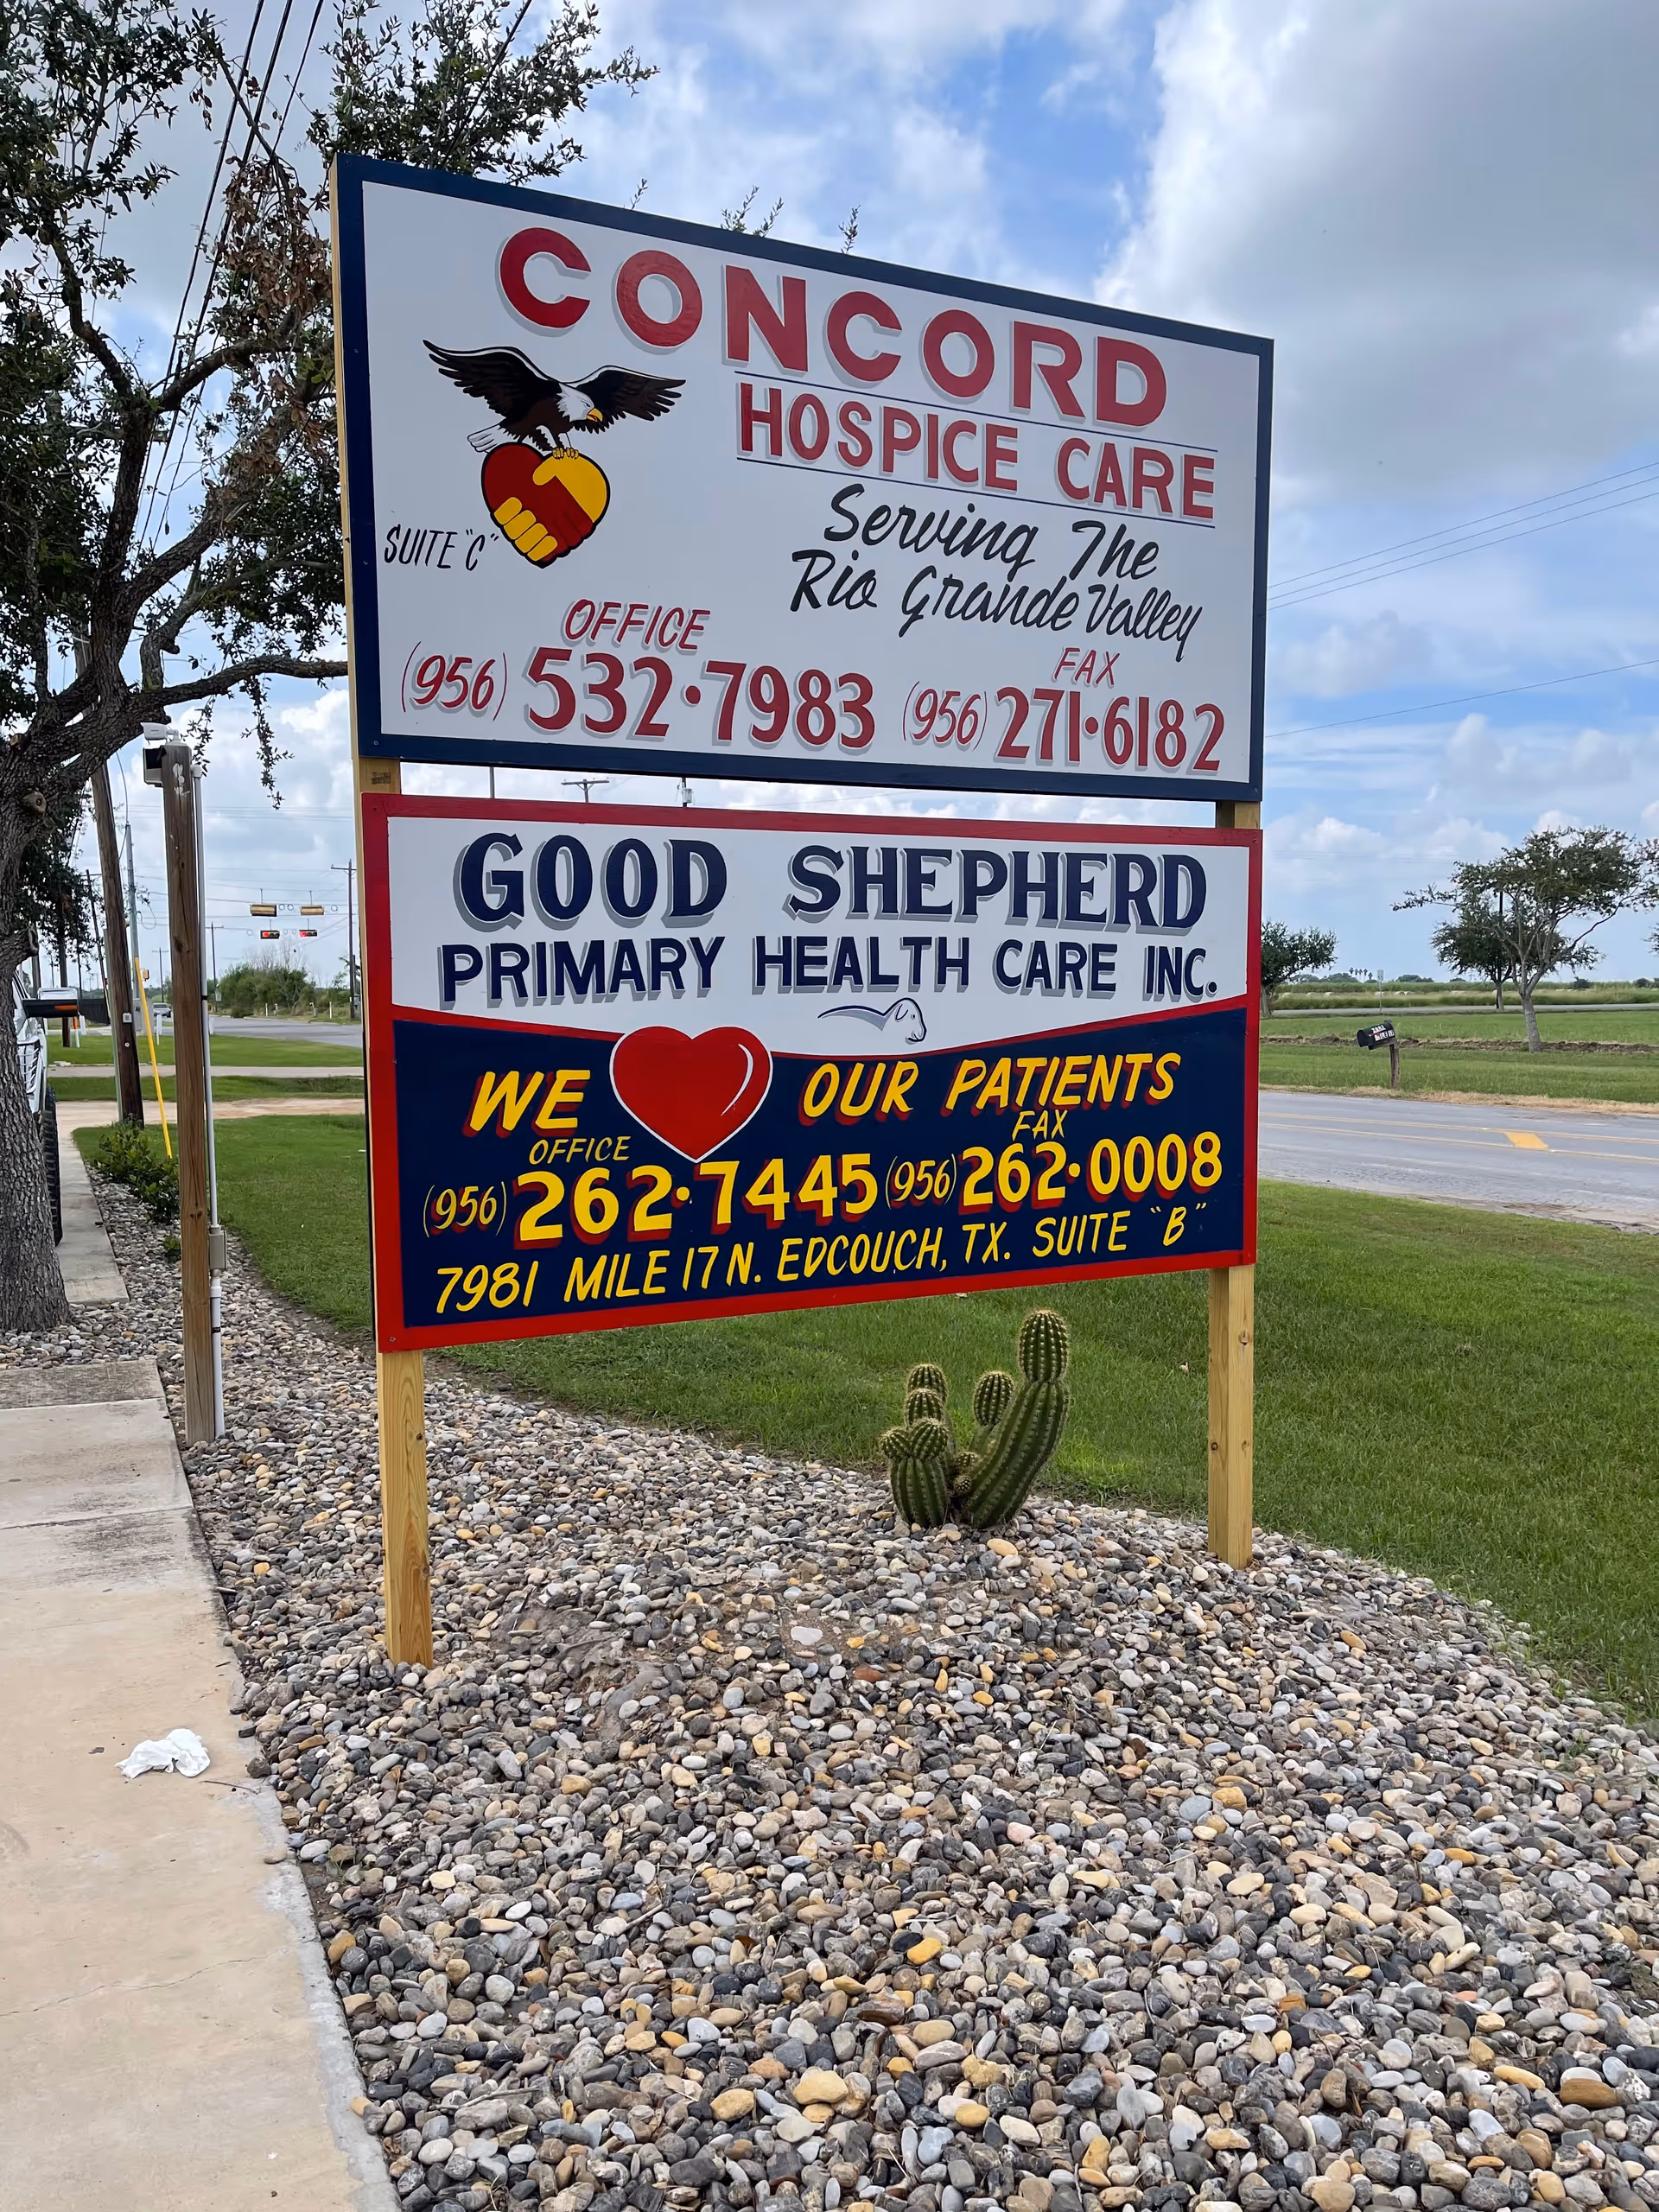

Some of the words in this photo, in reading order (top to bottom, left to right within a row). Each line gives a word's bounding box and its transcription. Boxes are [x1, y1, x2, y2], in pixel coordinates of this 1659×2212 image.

[497, 226, 1167, 428] CONCORD
[738, 382, 1019, 493] HOSPICE
[1056, 437, 1215, 519] CARE
[384, 524, 458, 569] SUITE
[823, 483, 1039, 581] Serving
[1069, 520, 1160, 581] The
[563, 598, 711, 652] OFFICE
[790, 549, 878, 613] Rio
[899, 565, 1081, 638] Grande
[1085, 584, 1204, 663] Valley
[400, 640, 508, 722] (956)
[1052, 646, 1121, 687] FAX
[902, 681, 989, 751] (956)
[457, 832, 728, 925] GOOD
[785, 844, 1207, 932] SHEPHERD
[440, 935, 726, 1005] PRIMARY
[753, 935, 970, 990] HEALTH
[995, 938, 1118, 995] CARE
[1144, 944, 1218, 998] INC.
[467, 1069, 591, 1134] WE
[801, 1060, 919, 1121] OUR
[944, 1052, 1181, 1112] PATIENTS
[1011, 1109, 1069, 1141] FAX
[528, 1135, 632, 1165] OFFICE
[884, 1154, 957, 1210] (956)
[423, 1180, 507, 1237] (956)
[435, 1260, 539, 1313] 7981
[563, 1249, 671, 1303] MILE
[682, 1246, 720, 1291] 17
[726, 1242, 762, 1285] N.
[776, 1227, 949, 1282] EDCOUCH,
[962, 1220, 1011, 1264] TX.
[1032, 1210, 1131, 1257] SUITE
